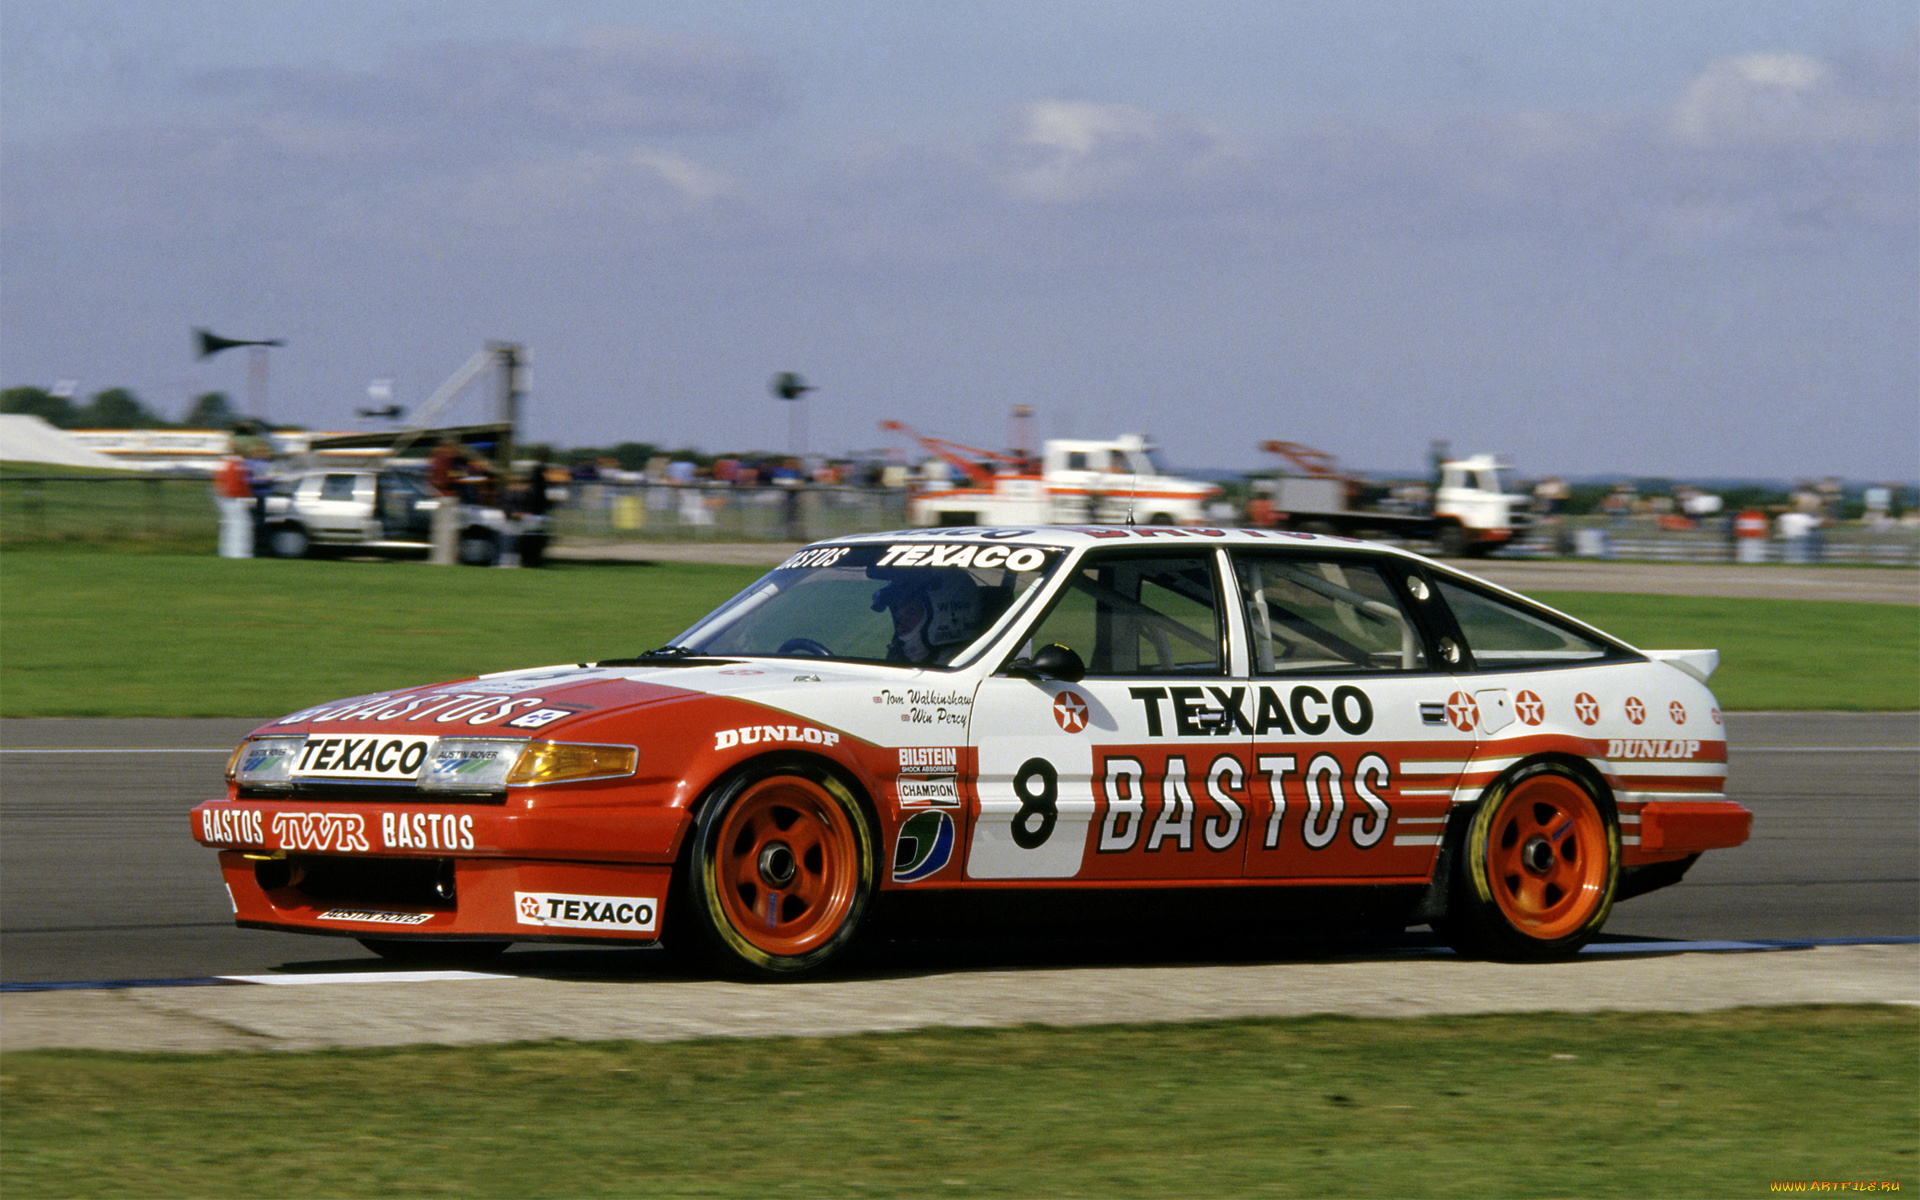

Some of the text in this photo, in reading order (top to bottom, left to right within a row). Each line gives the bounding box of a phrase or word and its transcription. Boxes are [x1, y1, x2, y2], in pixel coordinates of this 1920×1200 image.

[876, 545, 1045, 572] TEXACO
[312, 694, 543, 724] BASTOS
[881, 689, 972, 705] Tom Walkinshaw
[910, 707, 967, 728] Win Percy
[1128, 685, 1373, 737] TEXACO
[715, 725, 839, 750] DUNLOP
[1606, 739, 1700, 758] DUNLOP
[298, 739, 428, 774] TEXACO
[438, 750, 498, 759] AUSTIN ROVER
[899, 748, 957, 765] BILSTEIN
[902, 785, 954, 796] CHAMPION
[1011, 757, 1059, 849] 8
[1096, 751, 1391, 854] BASTOS
[203, 809, 475, 851] BASTOS TWR BASTOS
[547, 898, 653, 925] TEXACO
